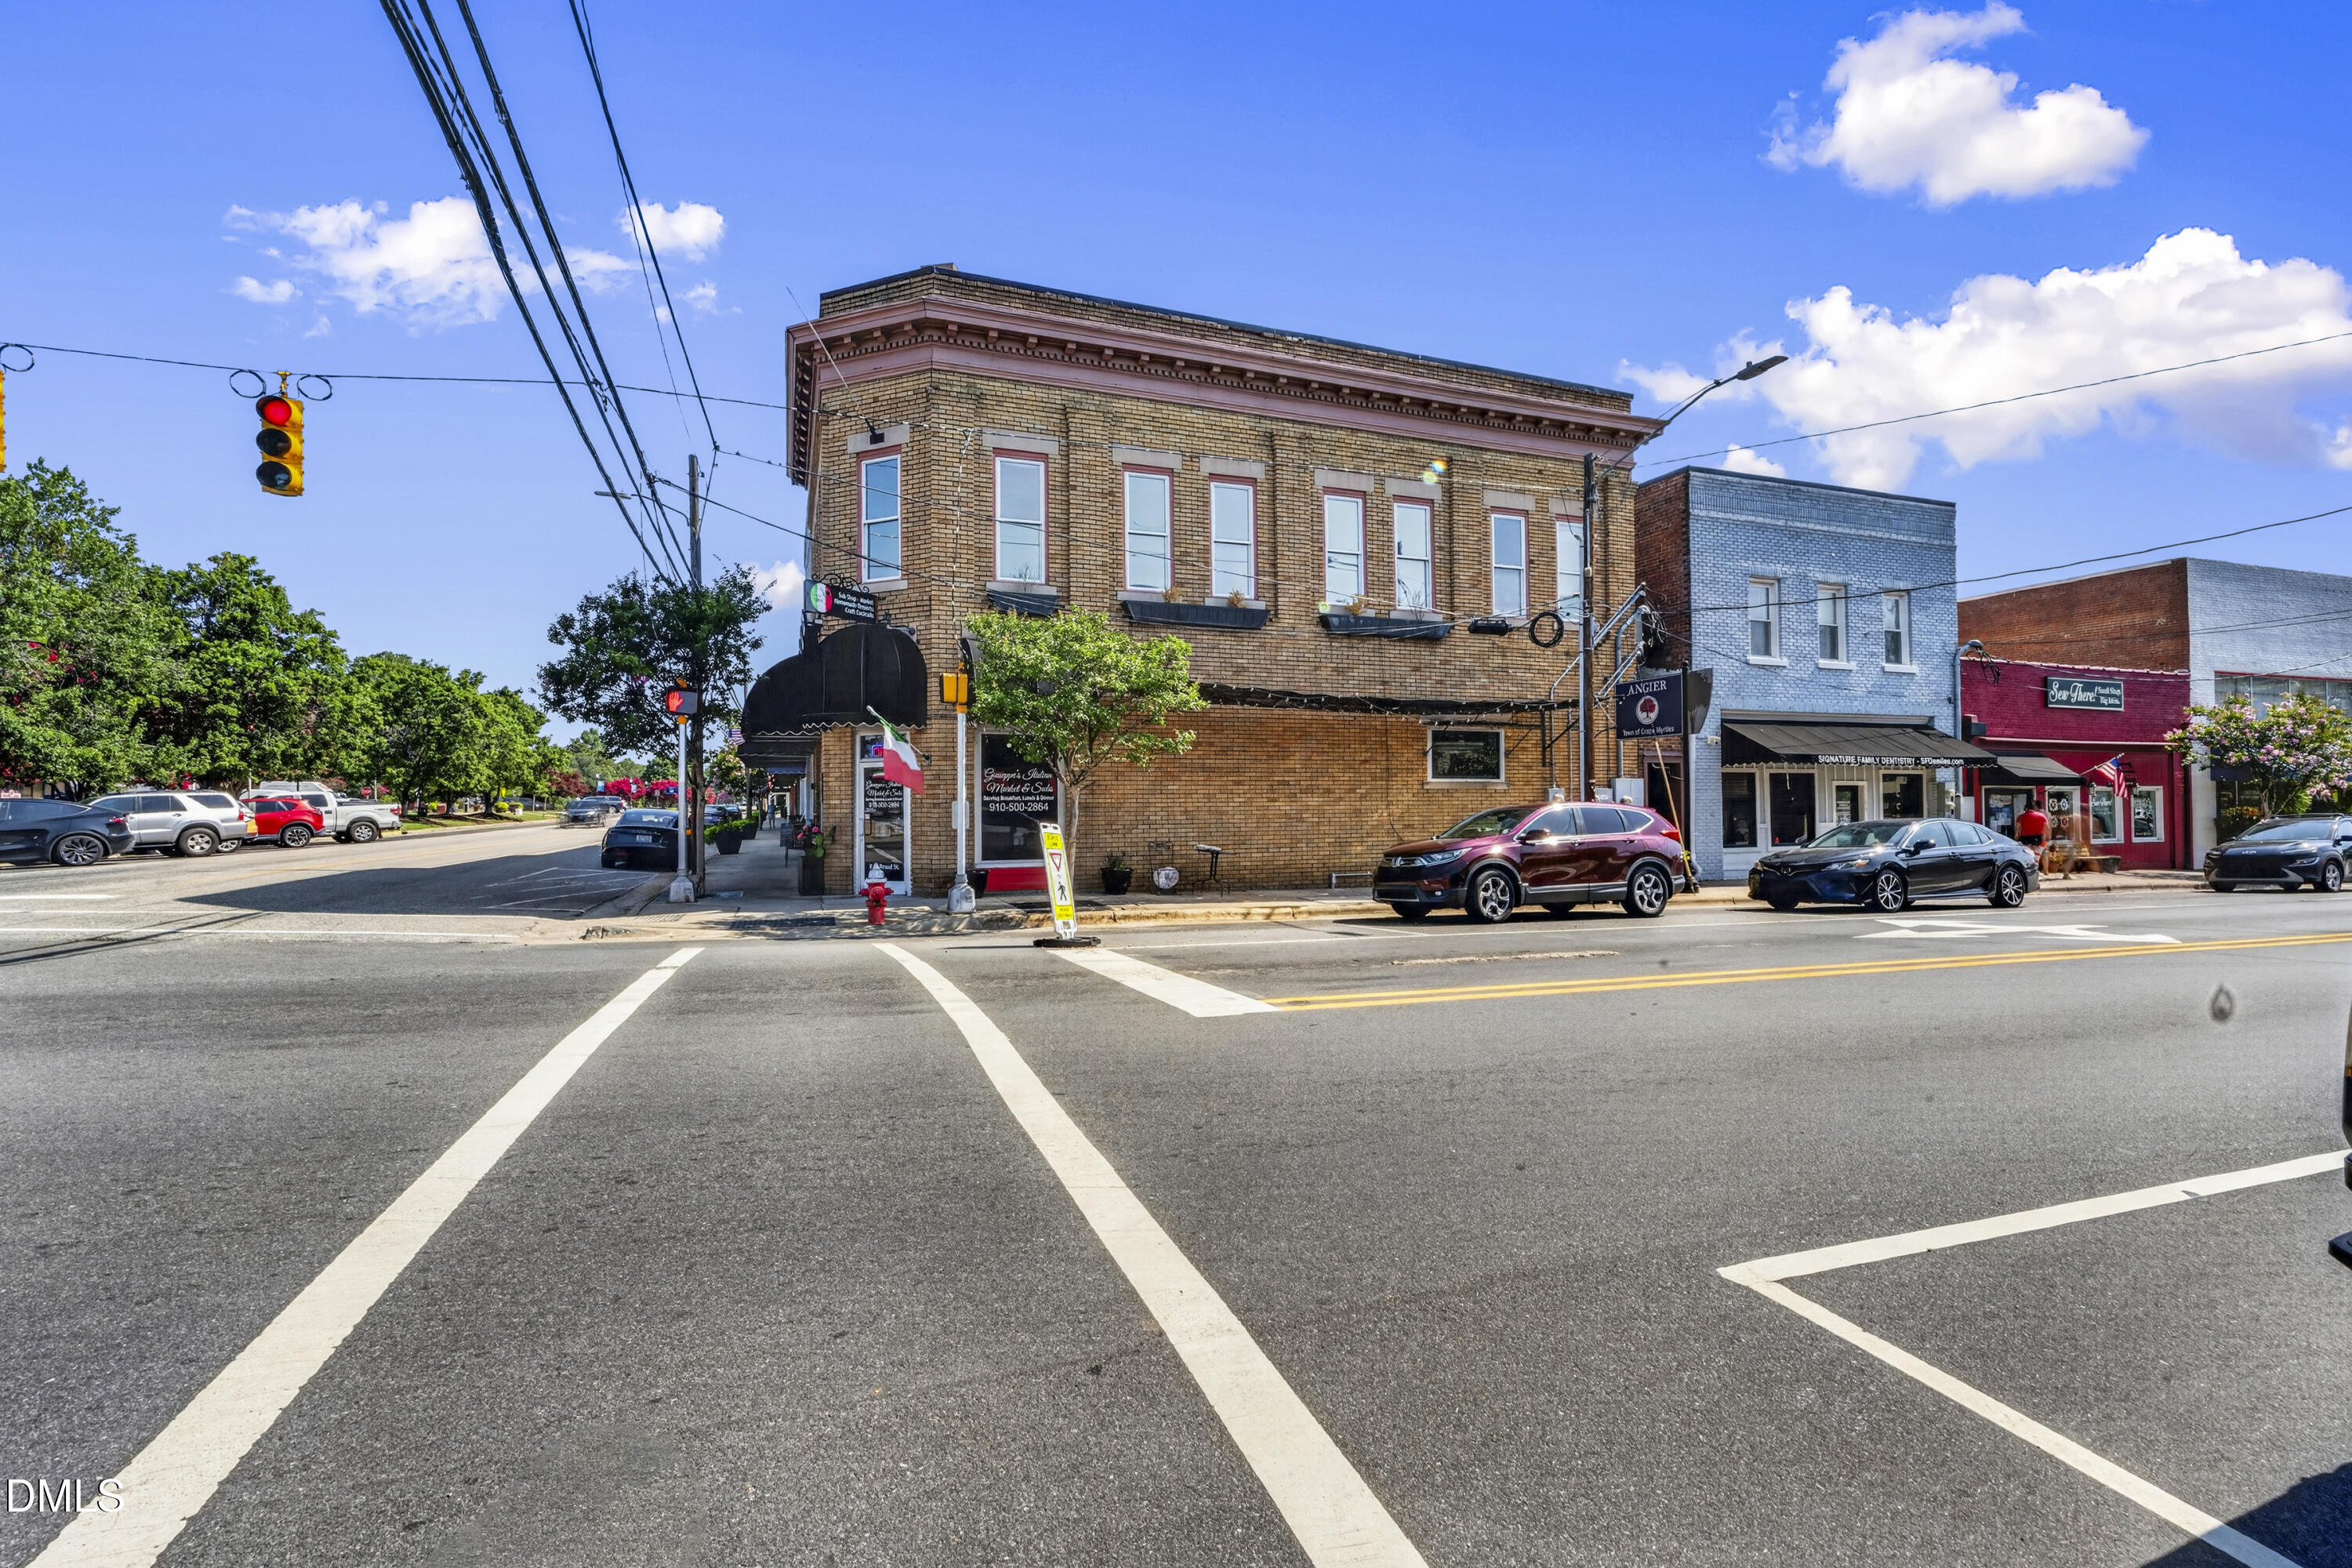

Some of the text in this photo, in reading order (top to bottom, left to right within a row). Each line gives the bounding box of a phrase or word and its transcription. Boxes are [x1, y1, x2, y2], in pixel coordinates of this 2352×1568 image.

[838, 591, 847, 600] Sub
[855, 609, 875, 618] Cocktails
[1628, 680, 1667, 695] ANGIER
[2049, 681, 2098, 702] Sew There!
[1818, 755, 1857, 764] SIGNATURE
[1857, 756, 1880, 764] FAMILY
[1881, 757, 1915, 765] DENTISTRY
[1022, 768, 1053, 781] Italian
[986, 782, 1054, 793] Market & Subs
[989, 802, 1049, 812] 910-500-2864
